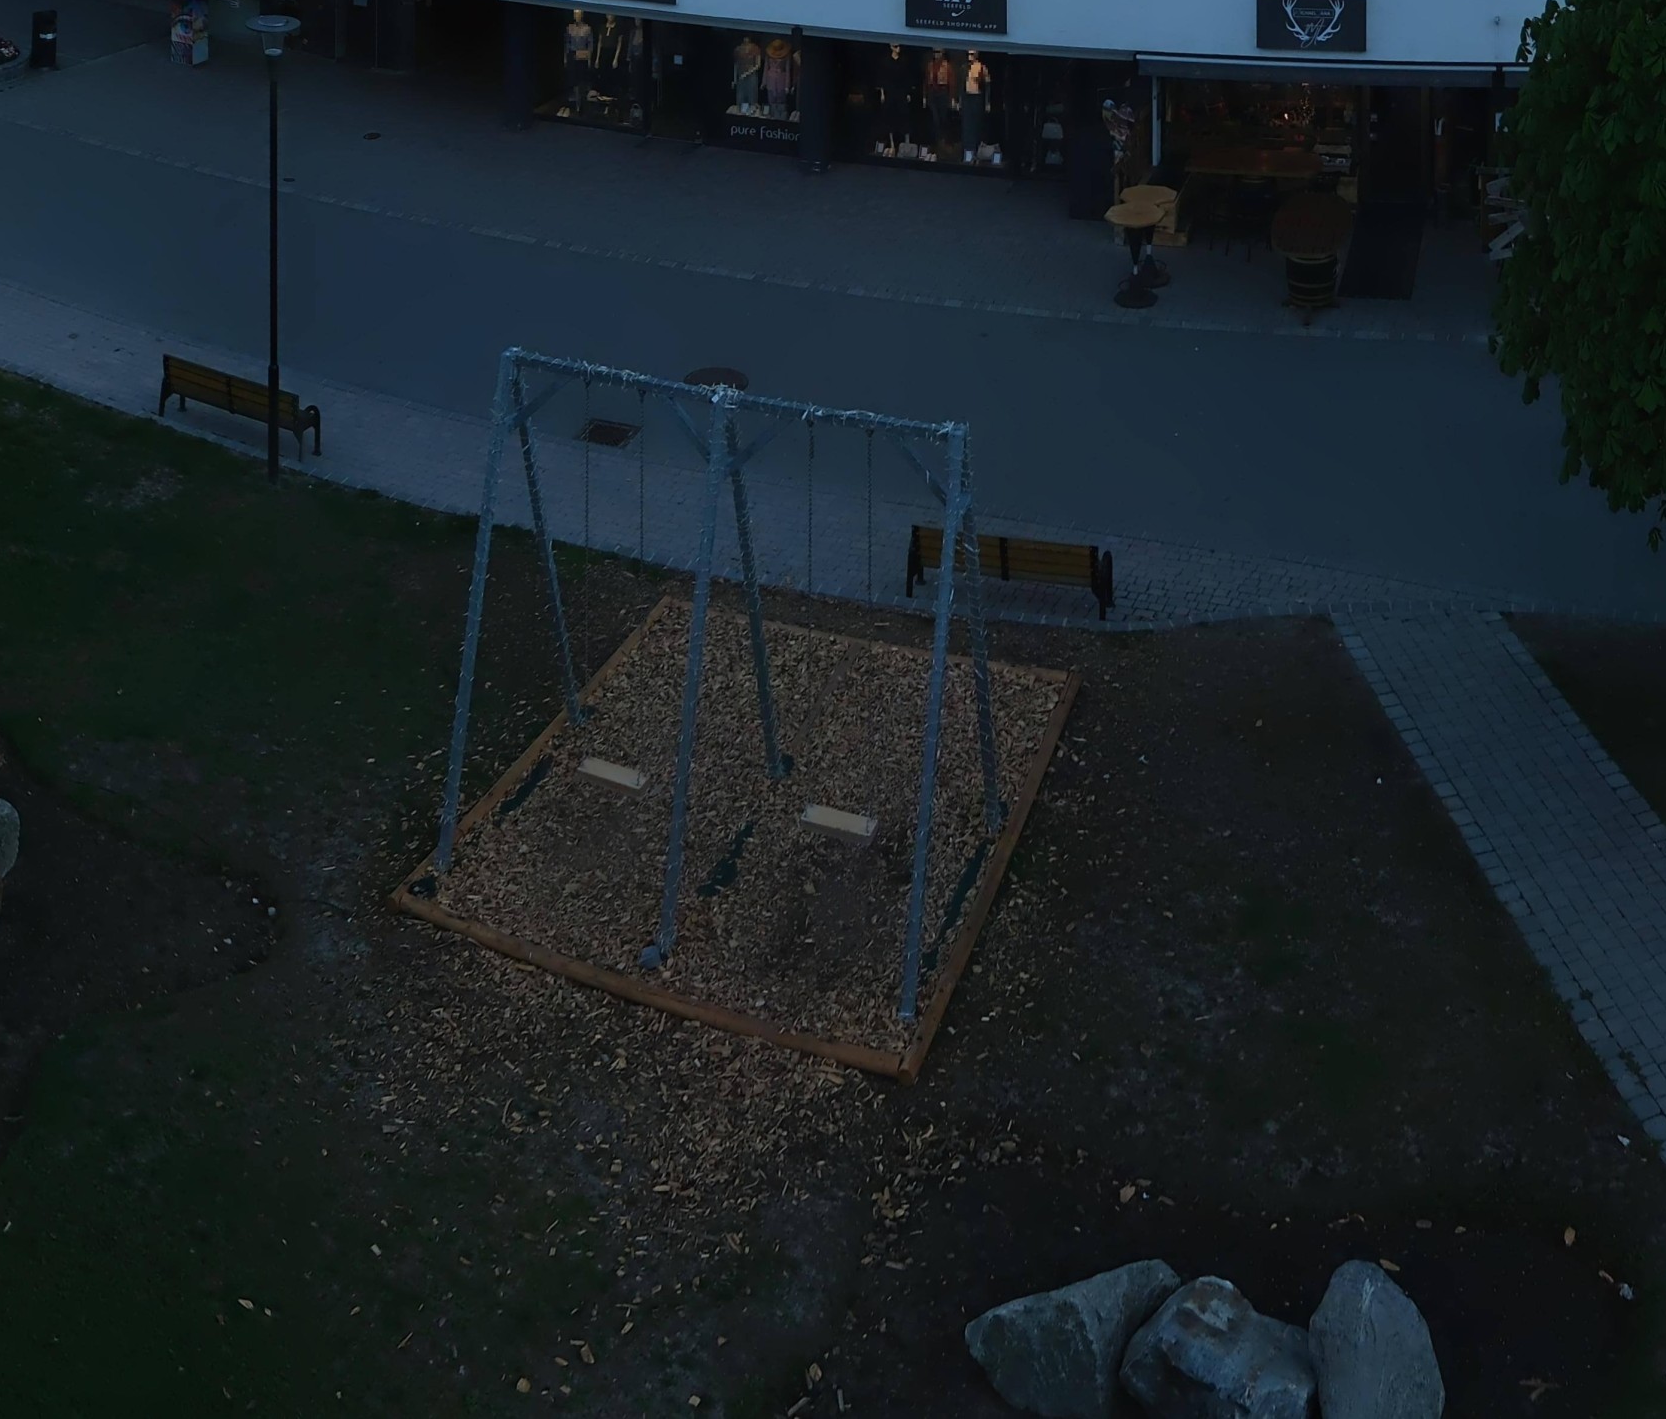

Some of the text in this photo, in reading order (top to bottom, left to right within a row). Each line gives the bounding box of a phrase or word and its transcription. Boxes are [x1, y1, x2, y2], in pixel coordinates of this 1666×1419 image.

[942, 2, 972, 10] SEEFELD
[915, 18, 945, 27] SEEFELD
[946, 21, 982, 29] SHOPPING
[730, 125, 757, 137] pure
